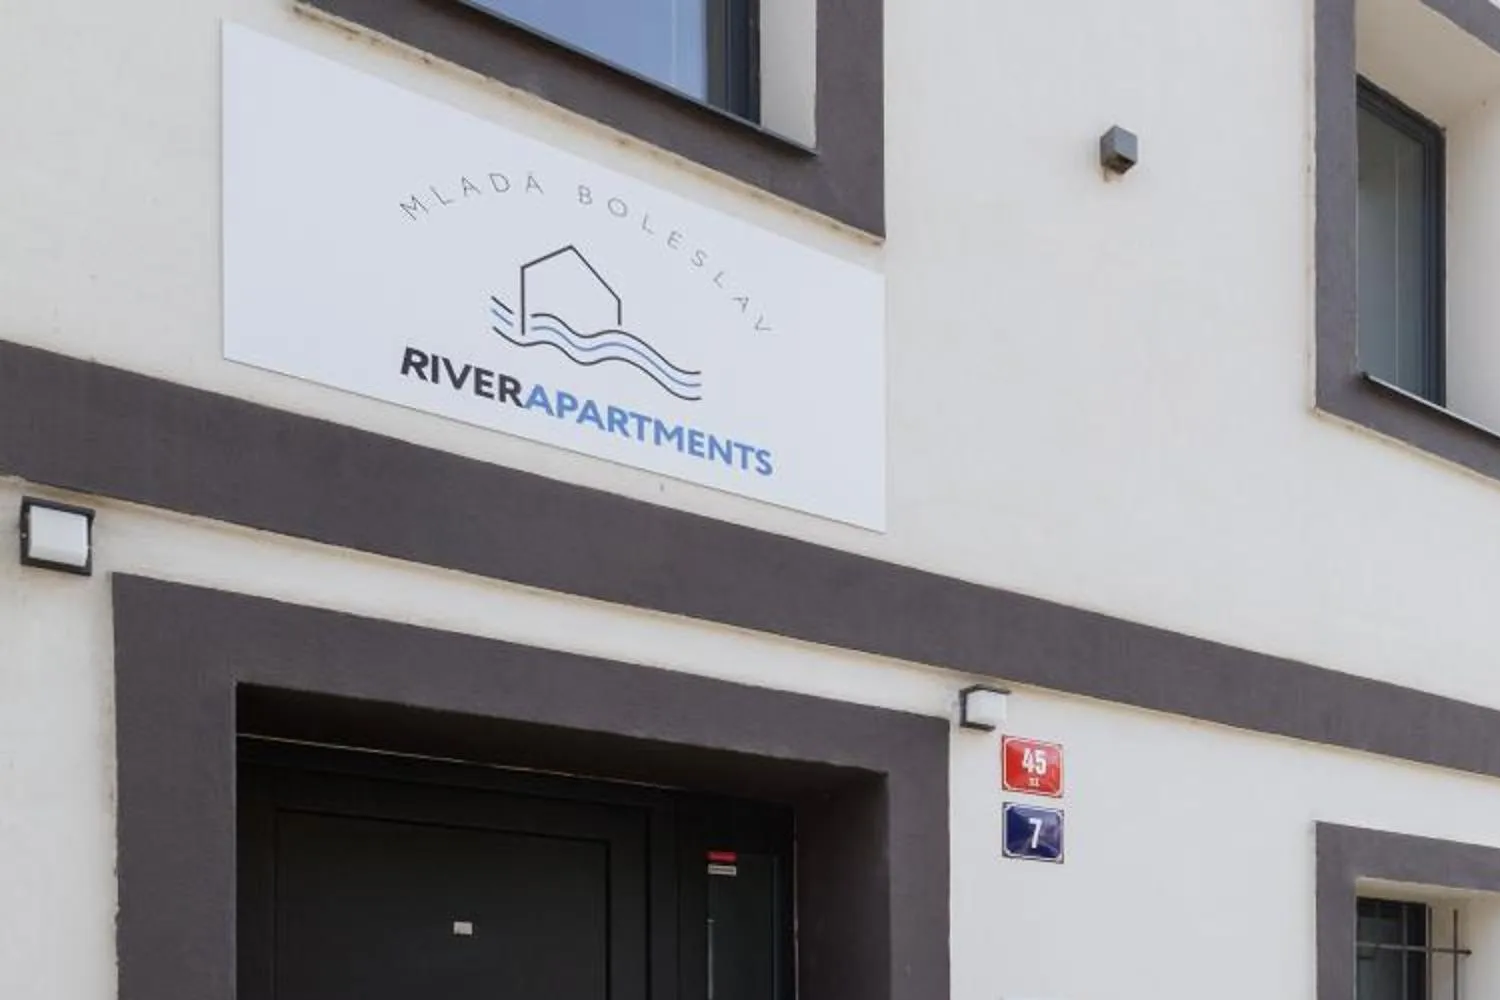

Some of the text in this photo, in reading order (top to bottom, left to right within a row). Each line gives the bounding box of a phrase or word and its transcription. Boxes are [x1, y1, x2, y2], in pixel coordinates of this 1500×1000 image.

[577, 184, 773, 332] BOLESLAV
[1021, 747, 1047, 775] 45
[1028, 817, 1043, 849] 7
